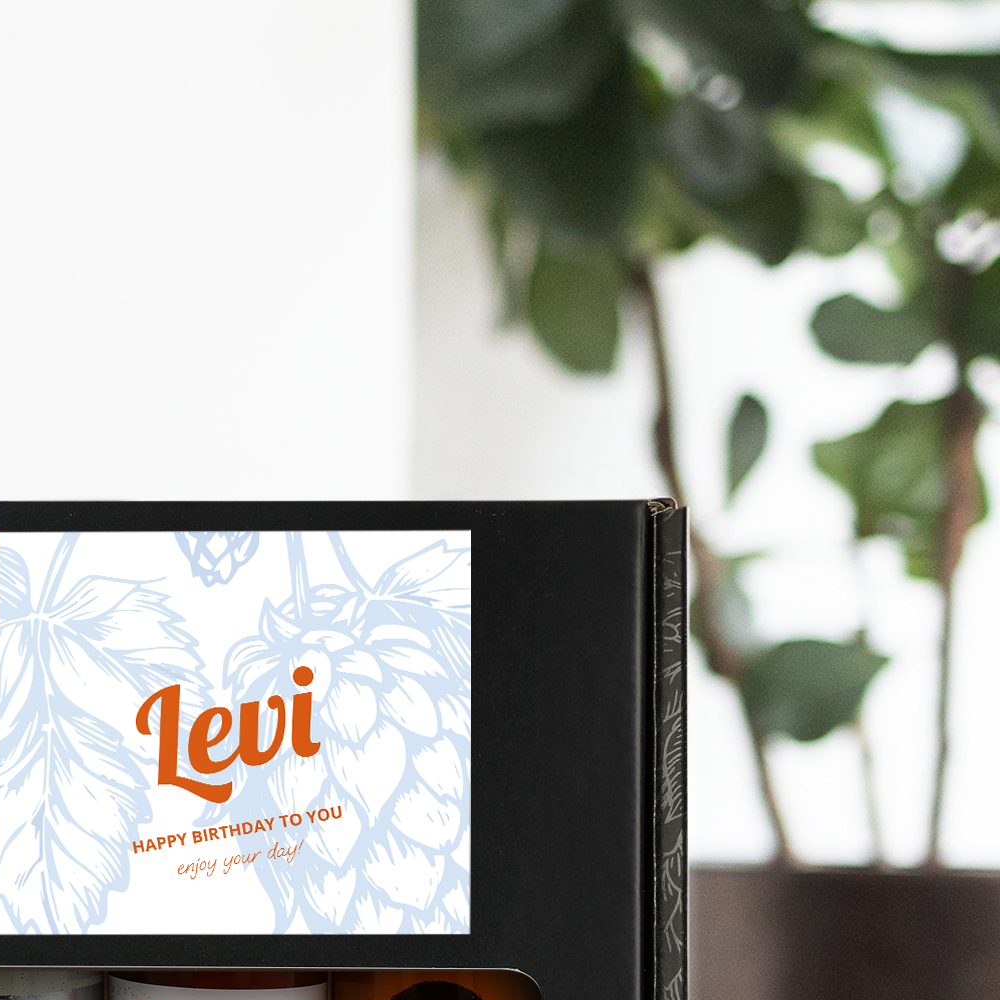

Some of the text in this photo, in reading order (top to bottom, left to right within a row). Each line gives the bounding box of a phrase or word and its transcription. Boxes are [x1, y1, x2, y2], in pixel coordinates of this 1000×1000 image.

[135, 665, 321, 803] Levi
[132, 805, 343, 854] HAPPY BIRTHDAY TO YOU
[177, 838, 304, 880] enjoy your day!
